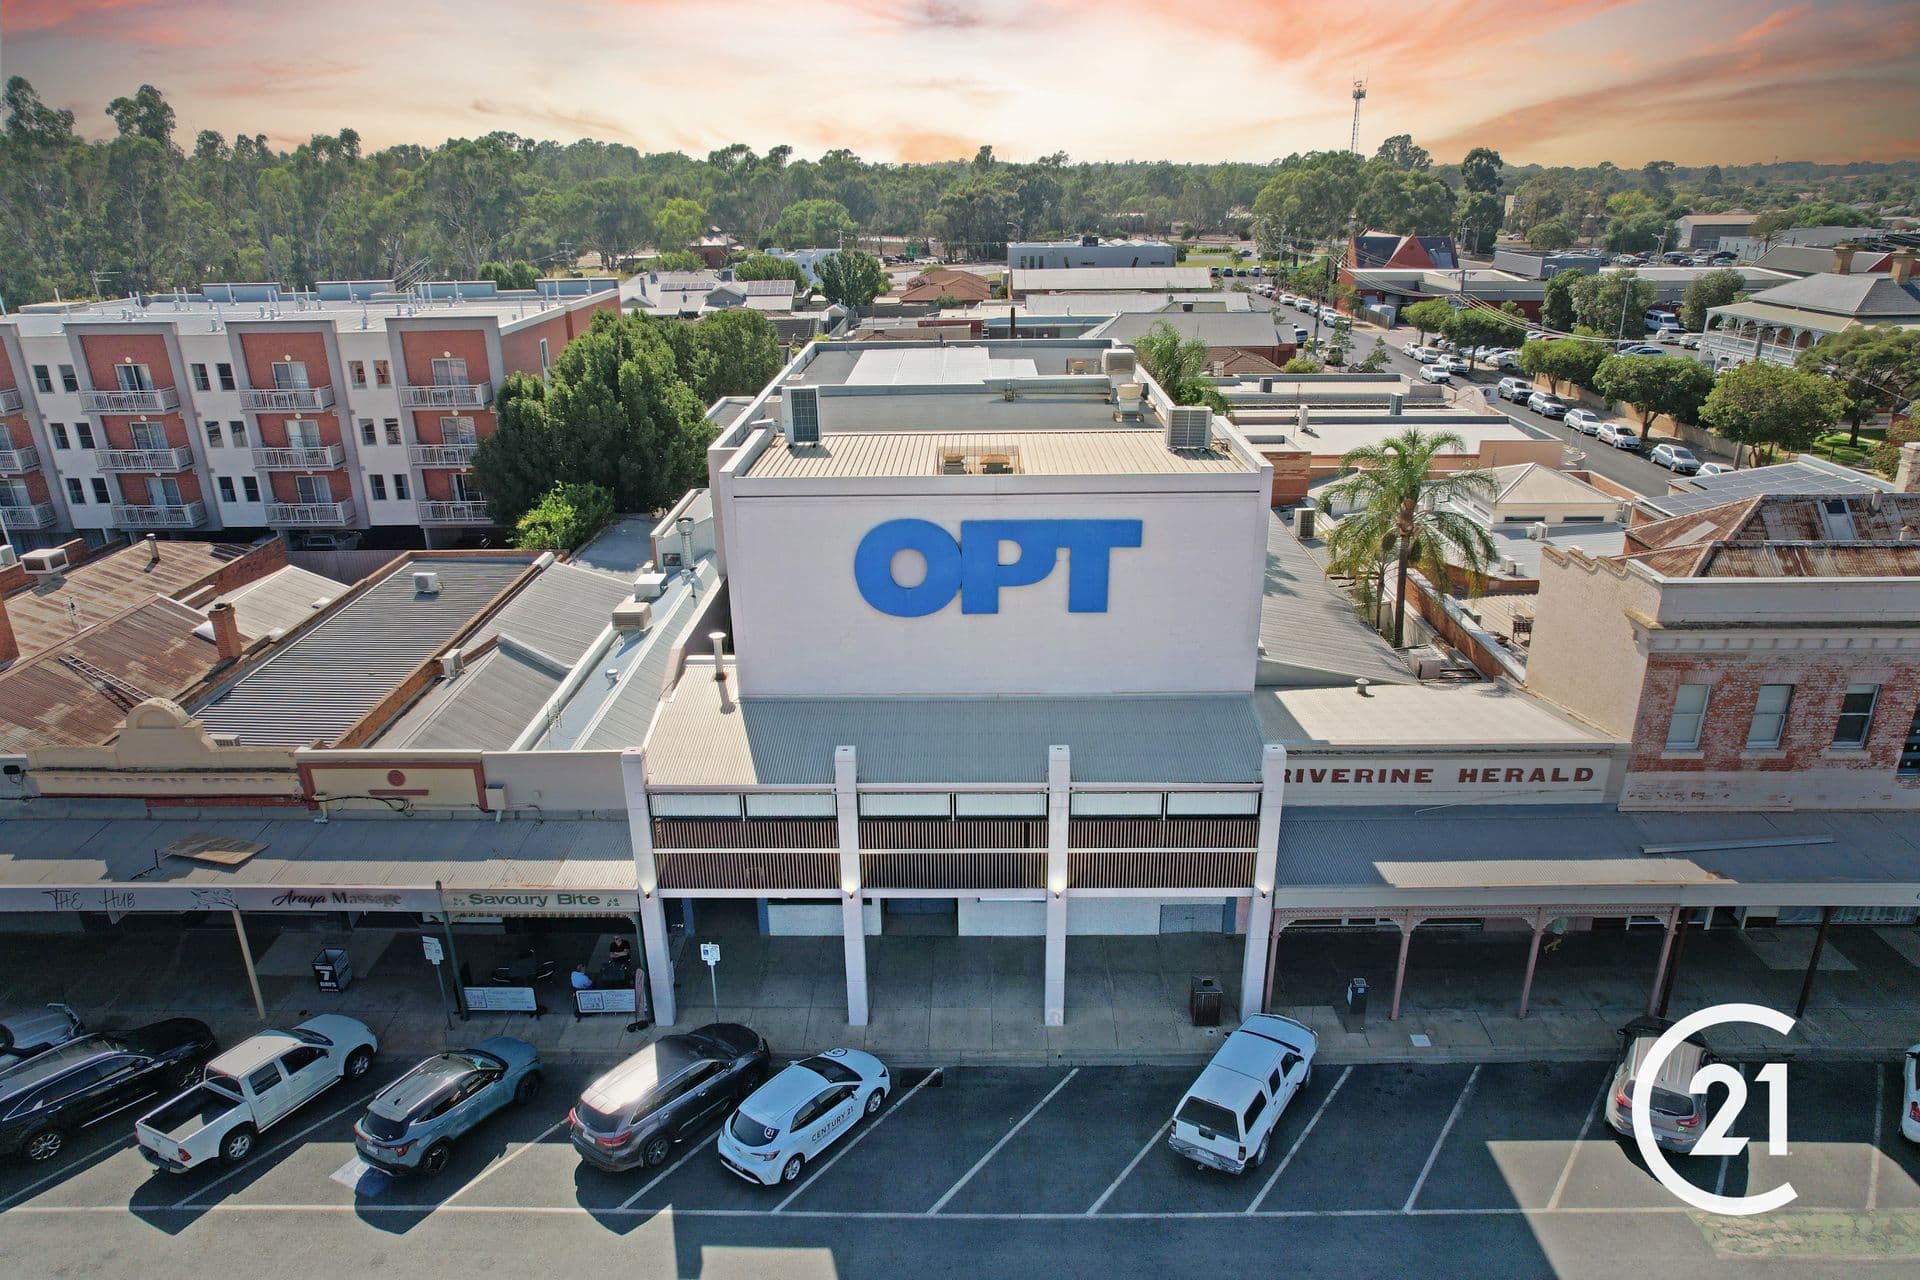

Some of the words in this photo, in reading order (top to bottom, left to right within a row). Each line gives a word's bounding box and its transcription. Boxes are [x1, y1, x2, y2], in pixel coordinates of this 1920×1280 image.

[854, 518, 1143, 617] OPT
[1458, 768, 1594, 783] HERALD
[41, 889, 82, 909] THE
[272, 890, 325, 908] Araya
[332, 892, 401, 907] Massage
[468, 893, 548, 907] Savoury
[557, 893, 600, 905] Bite
[320, 971, 330, 980] 7
[811, 1111, 846, 1143] CENTURY
[847, 1105, 855, 1117] 21
